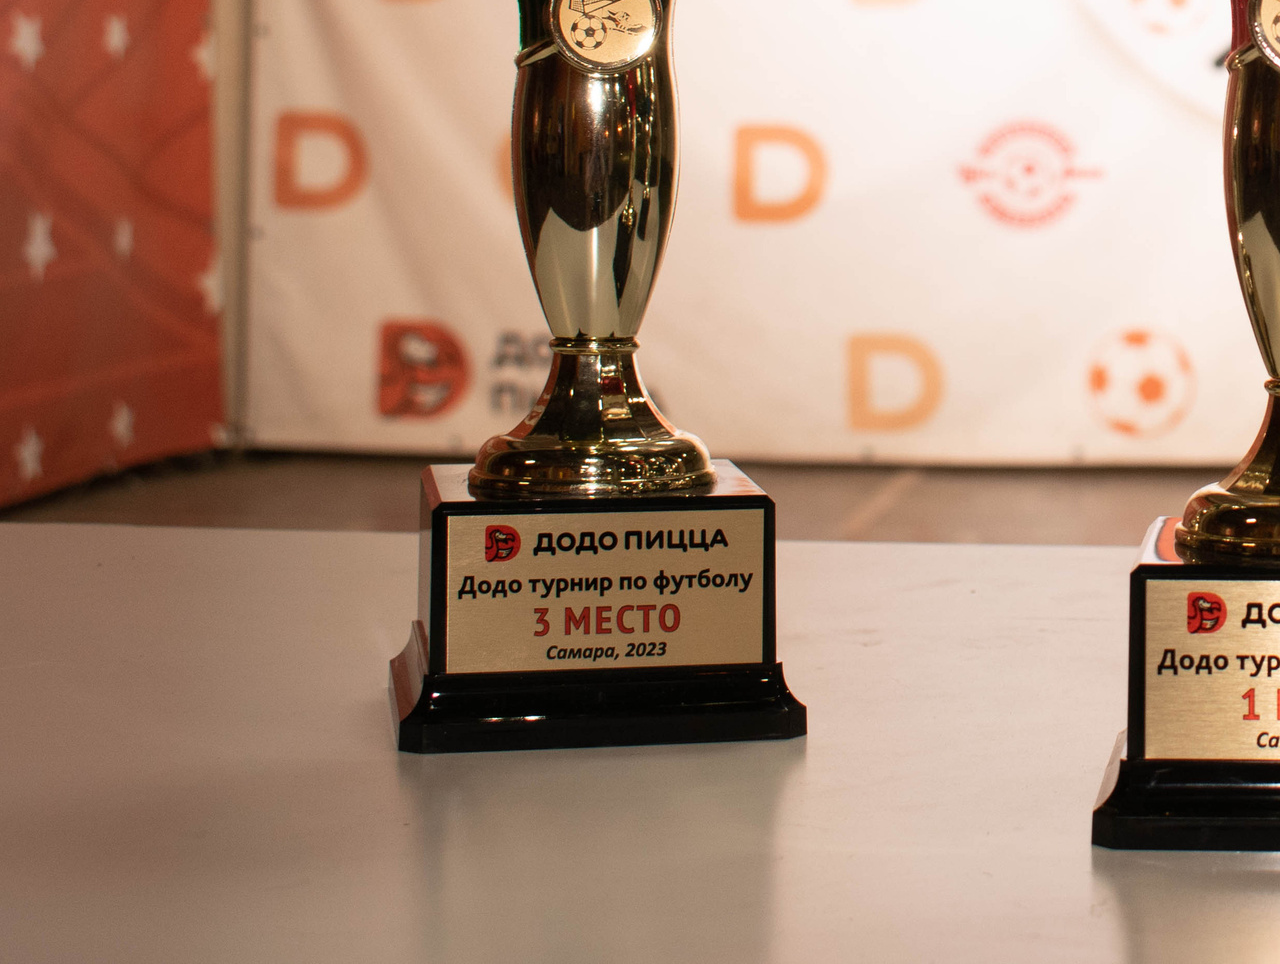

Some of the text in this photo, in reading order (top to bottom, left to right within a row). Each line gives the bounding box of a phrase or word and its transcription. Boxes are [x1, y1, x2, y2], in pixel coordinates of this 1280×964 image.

[533, 529, 728, 556] ДОДО ПИЦЦА
[458, 569, 753, 599] Додо турнир по футболу
[533, 603, 681, 637] 3 МЕСТО
[546, 642, 667, 661] Самара, 2023
[1157, 648, 1229, 676] Додо
[1242, 688, 1260, 721] 1
